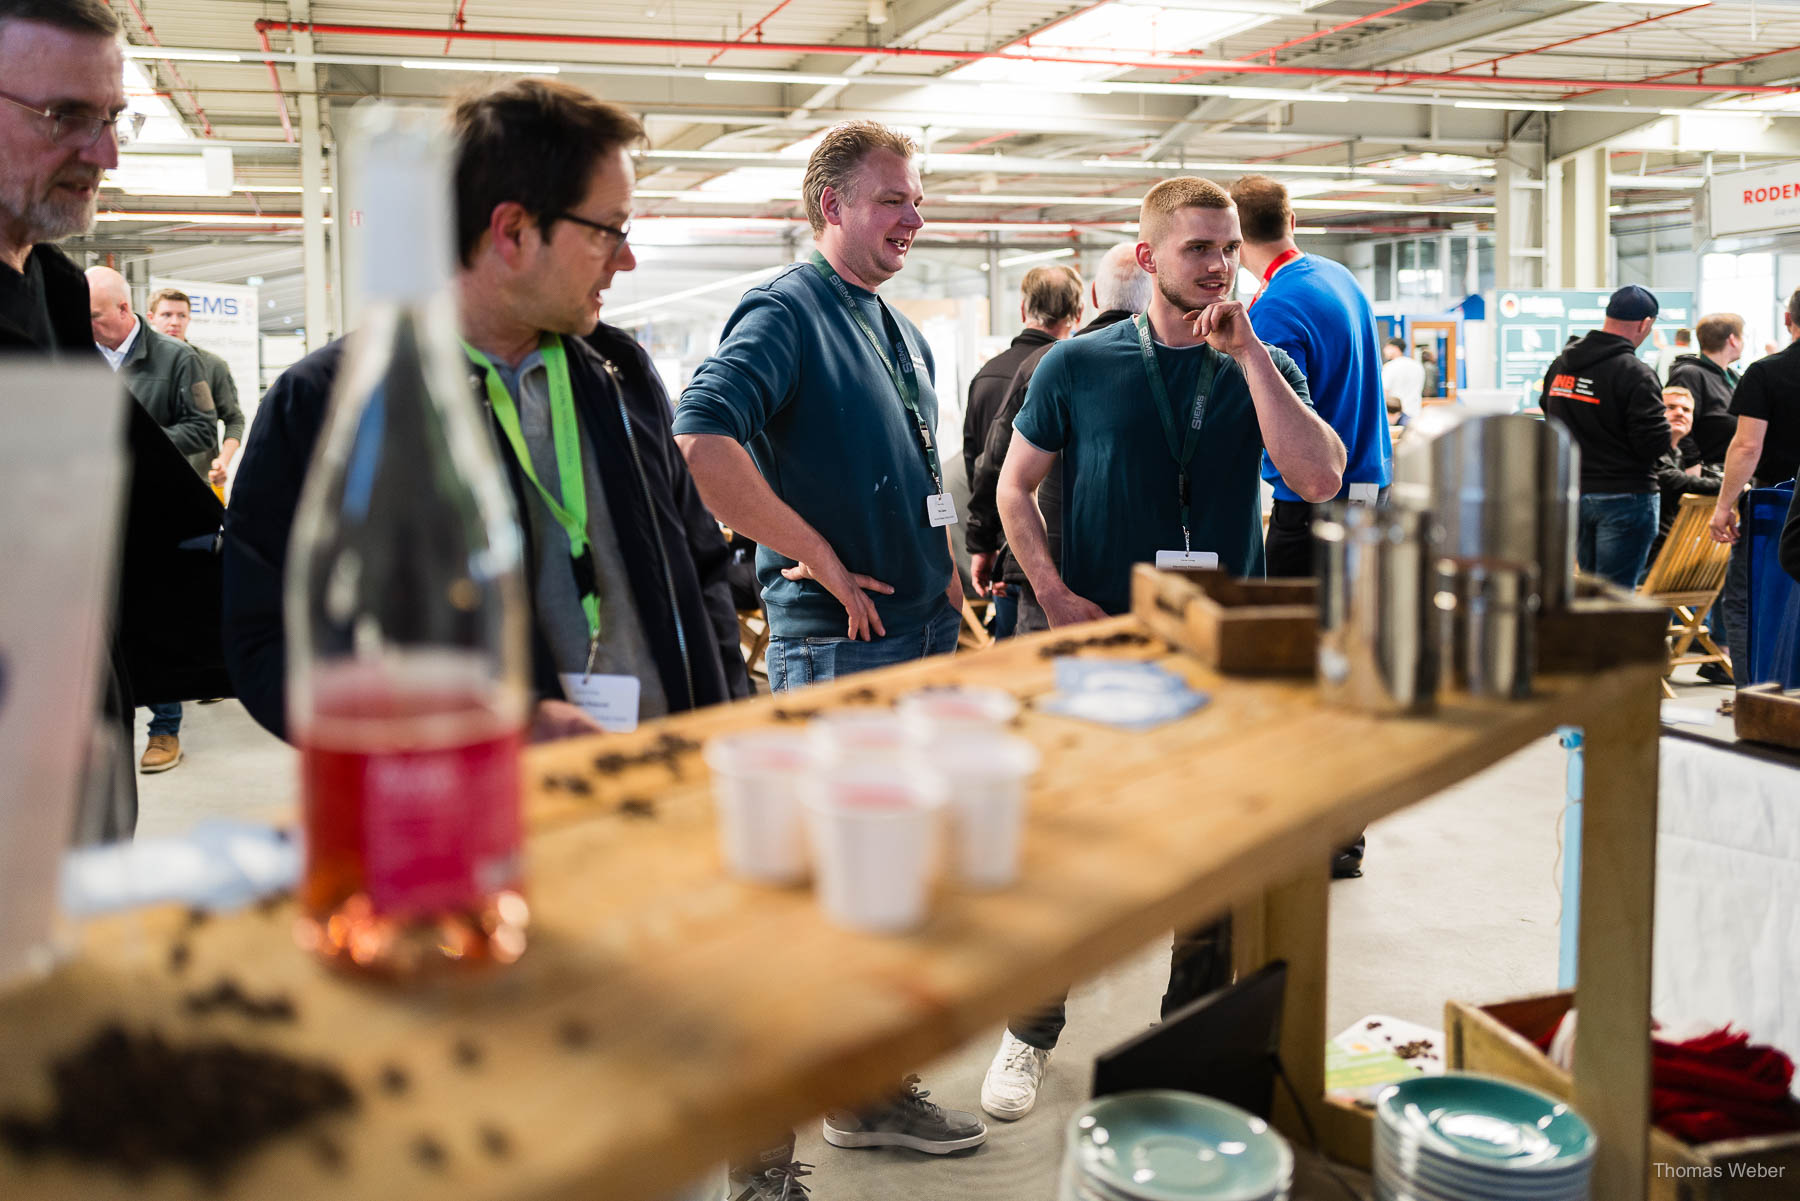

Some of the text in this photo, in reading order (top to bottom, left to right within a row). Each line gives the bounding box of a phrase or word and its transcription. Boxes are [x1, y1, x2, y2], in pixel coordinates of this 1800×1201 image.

[189, 295, 238, 315] EMS
[829, 274, 857, 308] SIEMS
[896, 341, 914, 373] SIEMS
[1140, 325, 1154, 357] SIEMS
[1191, 395, 1205, 430] SIEMS
